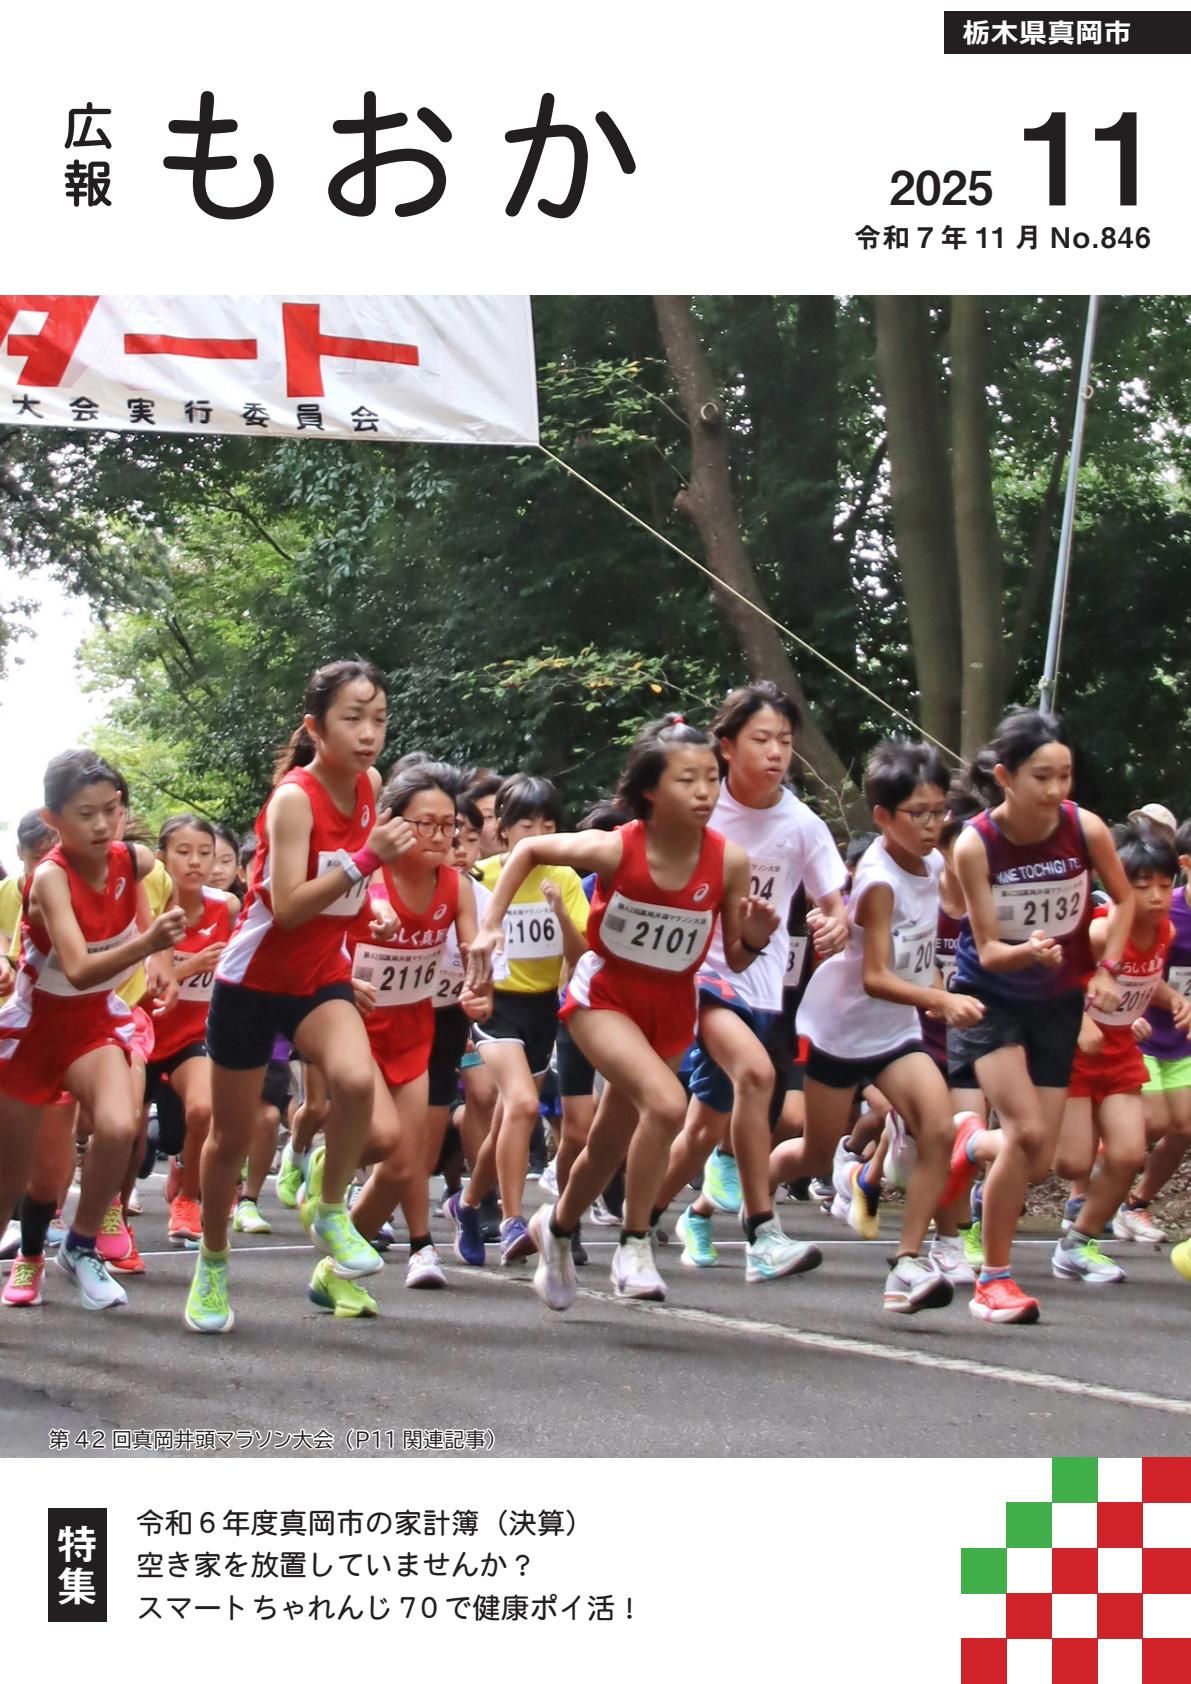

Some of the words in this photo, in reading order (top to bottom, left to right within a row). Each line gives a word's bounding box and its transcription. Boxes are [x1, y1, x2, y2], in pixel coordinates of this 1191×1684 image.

[962, 19, 1131, 46] 栃木県真岡市
[64, 101, 112, 208] 広報
[162, 90, 637, 220] もおか
[889, 169, 993, 207] 2025
[1023, 111, 1138, 206] 11
[1050, 224, 1151, 250] No.846
[11, 393, 381, 433] 大会実行委員会
[1020, 859, 1067, 880] TOCHIGI
[1024, 891, 1080, 926] 2132
[630, 921, 698, 954] 2101
[380, 961, 437, 991] 2116
[437, 978, 465, 998] 24
[57, 1525, 97, 1605] 特集
[137, 1551, 530, 1579] 空き家を放置していませんか？
